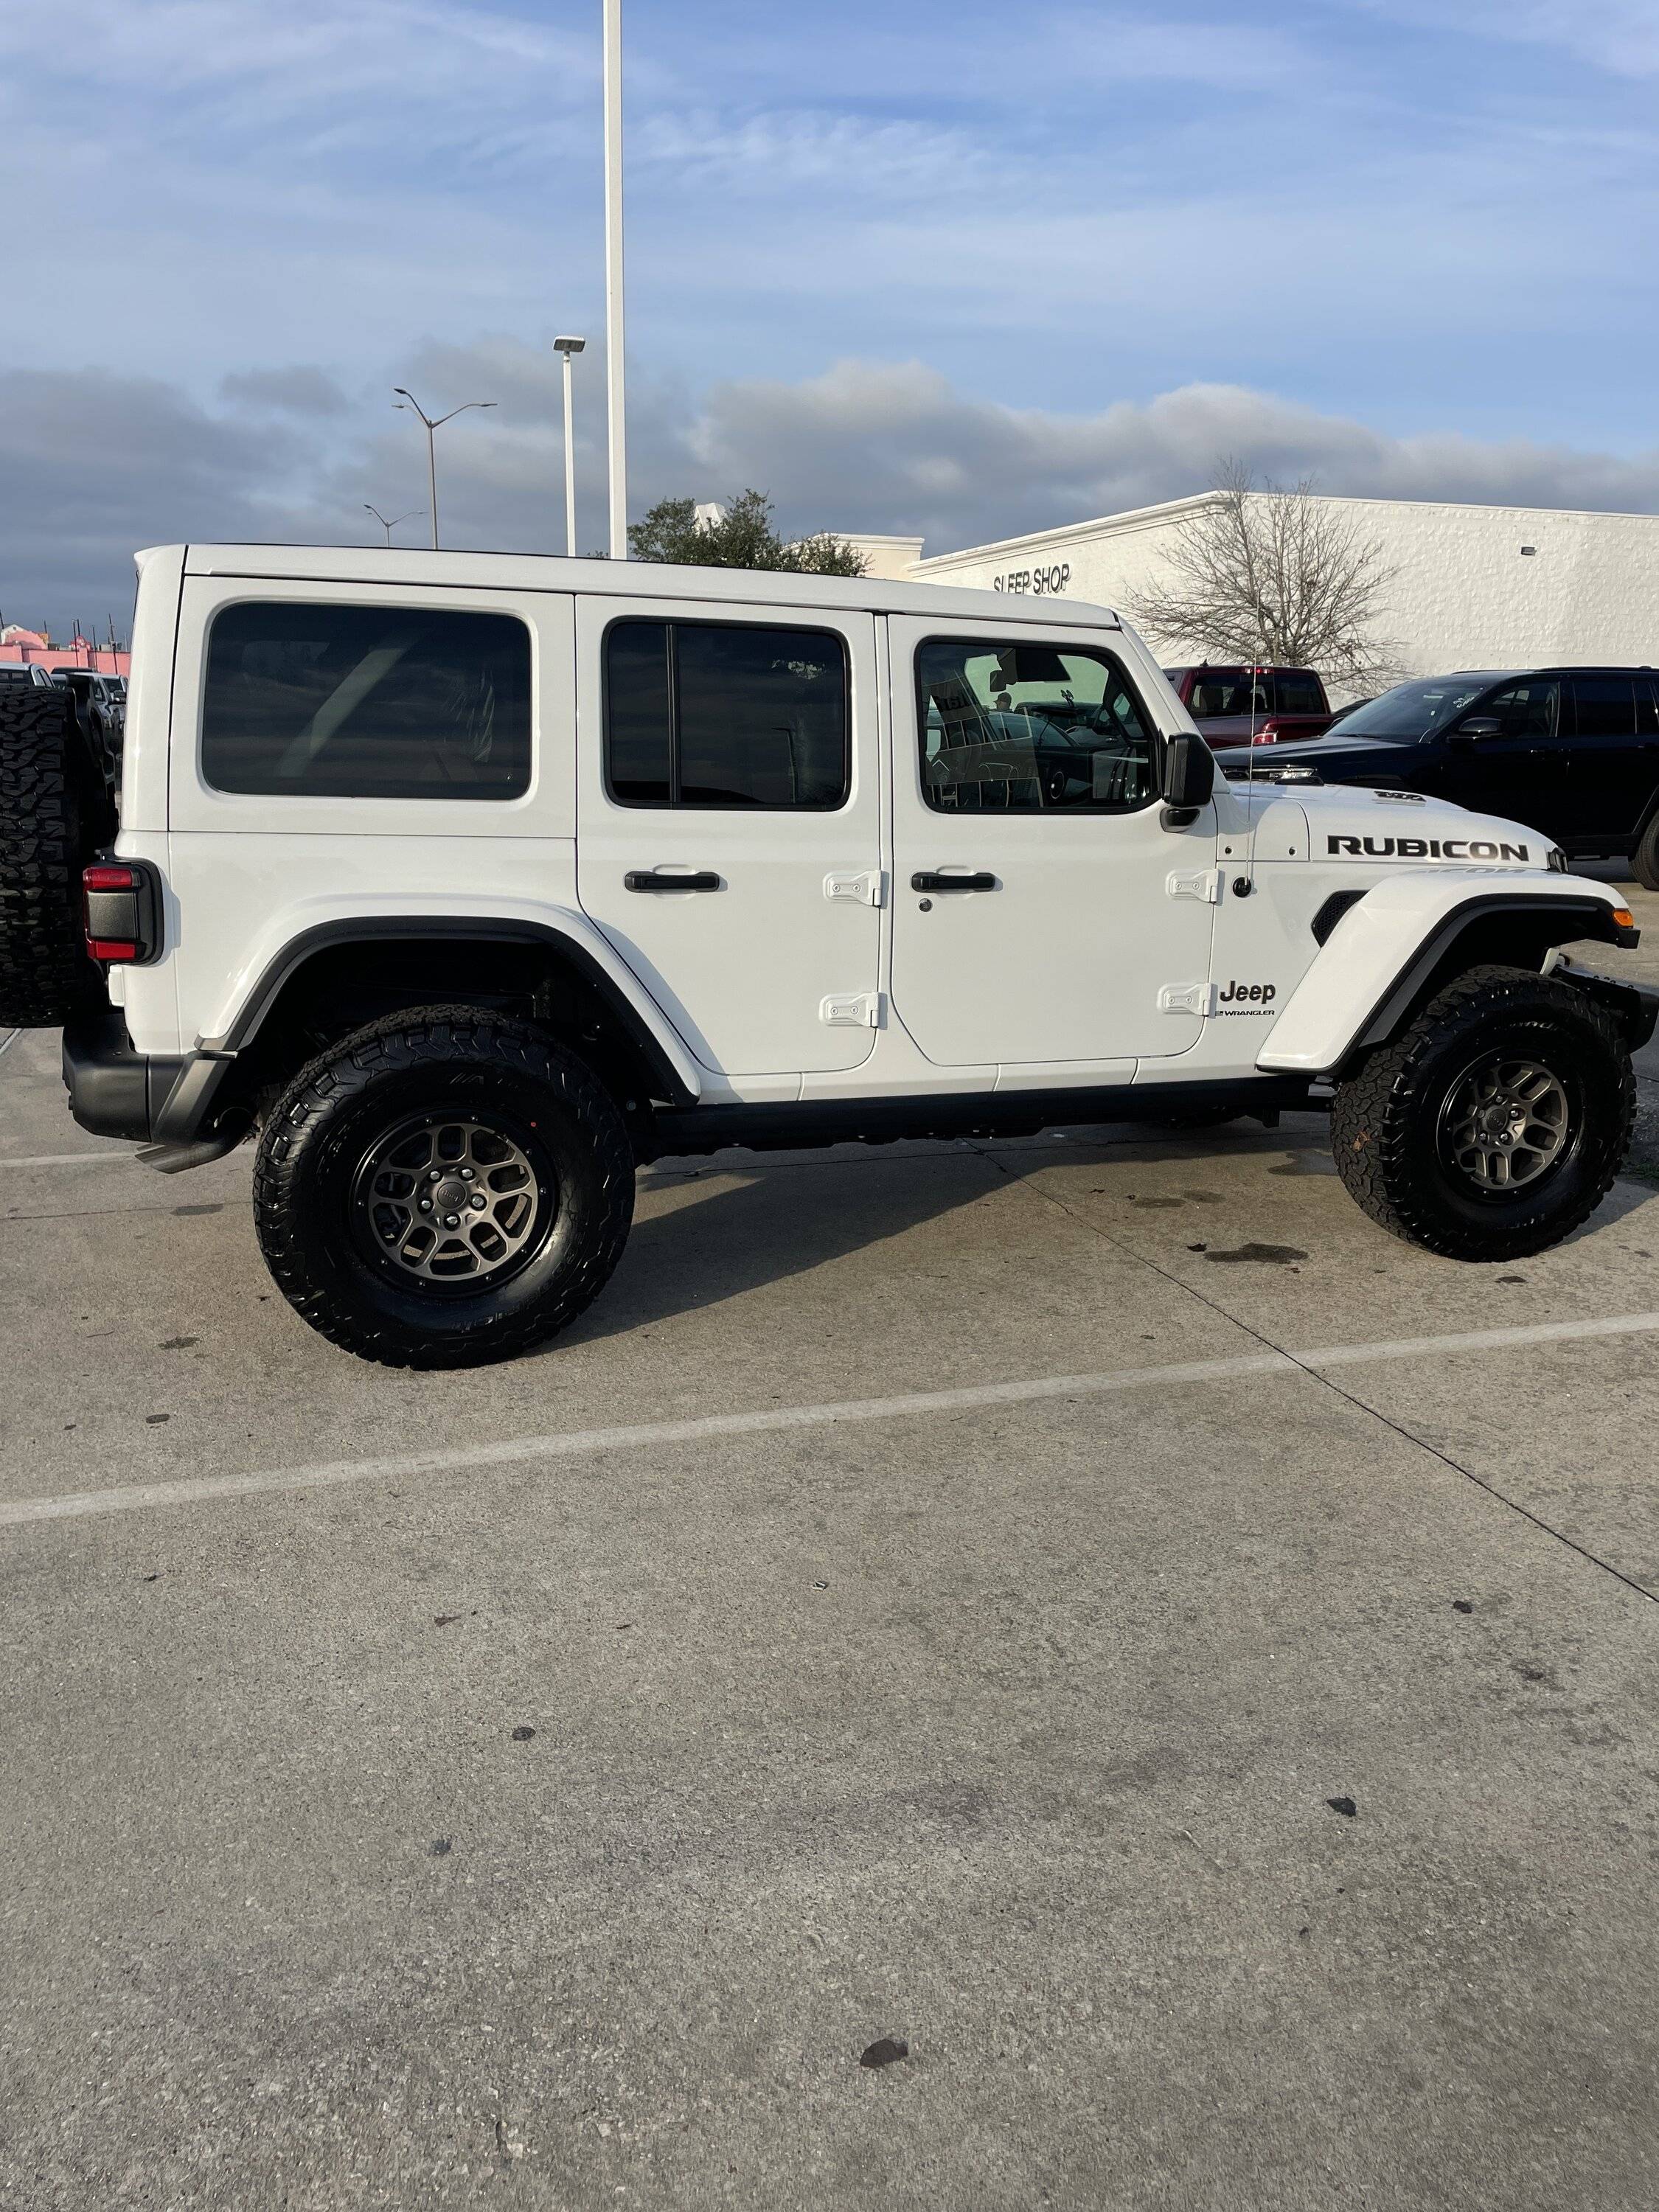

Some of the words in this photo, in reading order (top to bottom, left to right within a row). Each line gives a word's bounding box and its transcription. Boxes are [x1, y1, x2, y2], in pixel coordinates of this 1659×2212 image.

[994, 571, 1030, 594] SLEEP
[1033, 563, 1071, 594] SHOP
[1327, 835, 1529, 862] RUBICON
[1220, 980, 1276, 1004] Jeep
